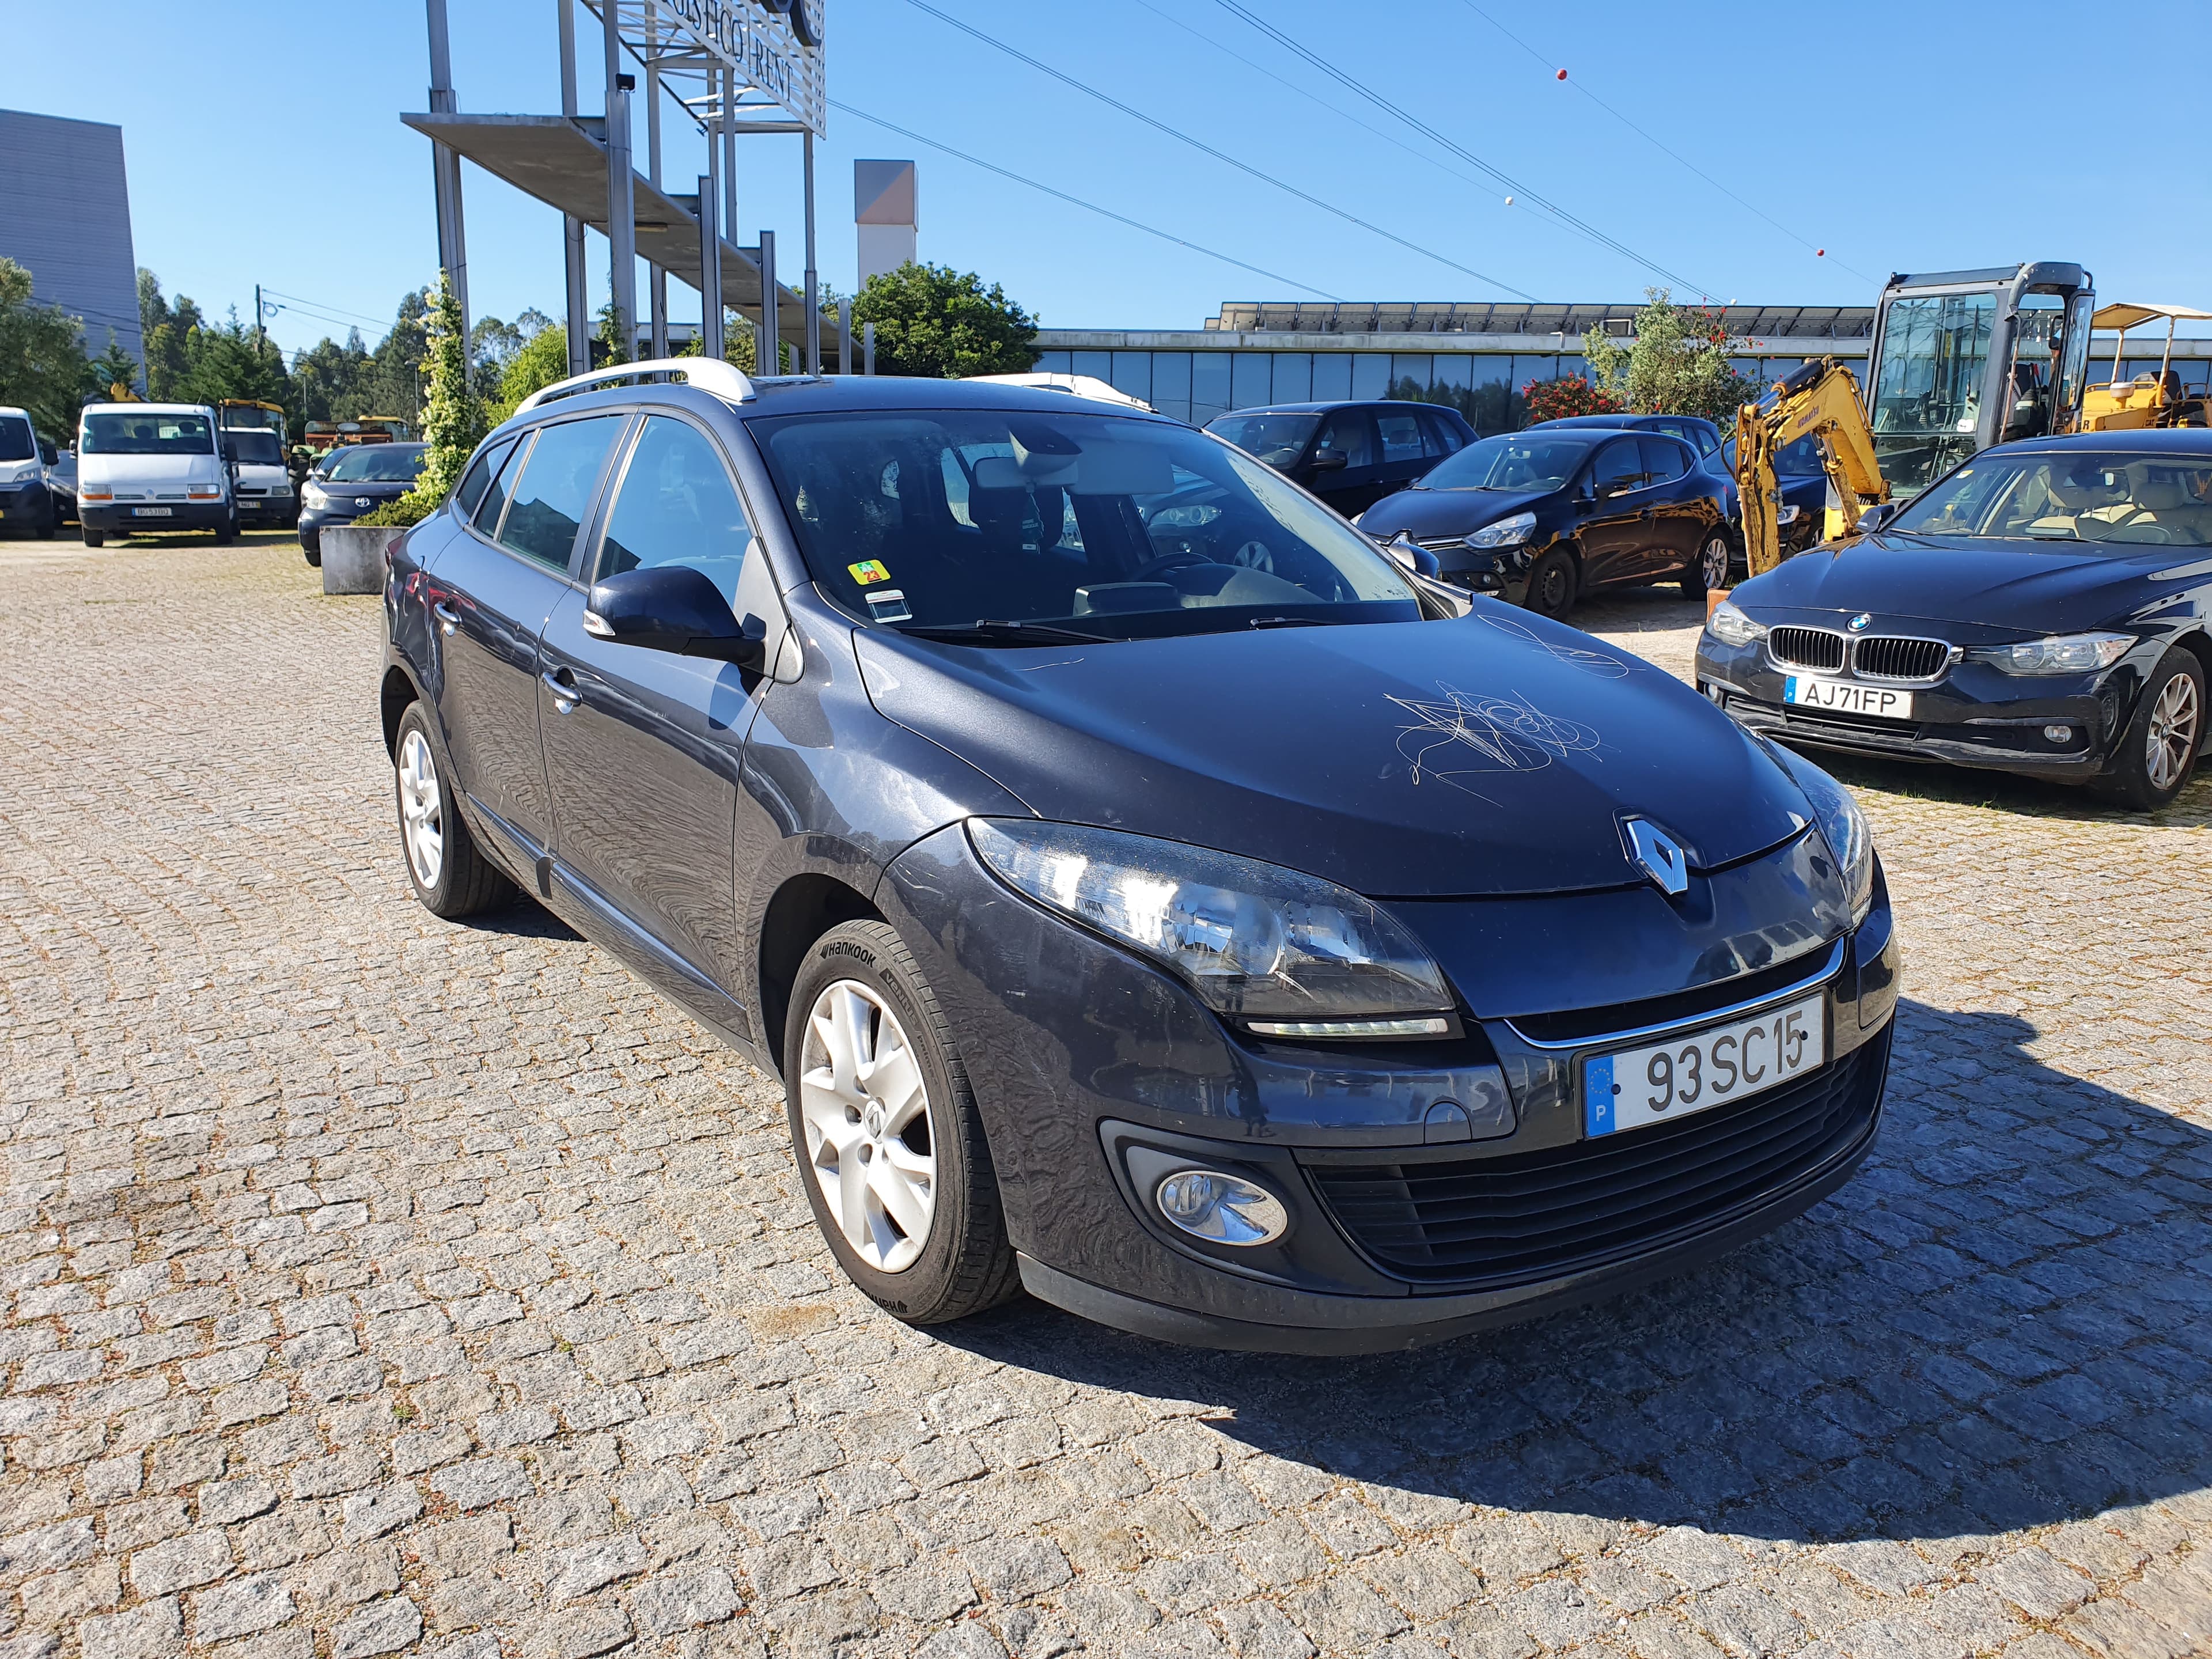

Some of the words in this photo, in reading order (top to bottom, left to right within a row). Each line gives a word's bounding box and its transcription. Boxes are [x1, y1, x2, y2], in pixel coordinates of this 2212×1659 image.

[755, 36, 793, 103] RENT
[1797, 404, 1820, 429] KOMATSU
[863, 570, 881, 581] 23
[1804, 683, 1897, 713] AJ71FP
[1595, 1104, 1607, 1122] P
[1647, 1010, 1802, 1112] 93SC15
